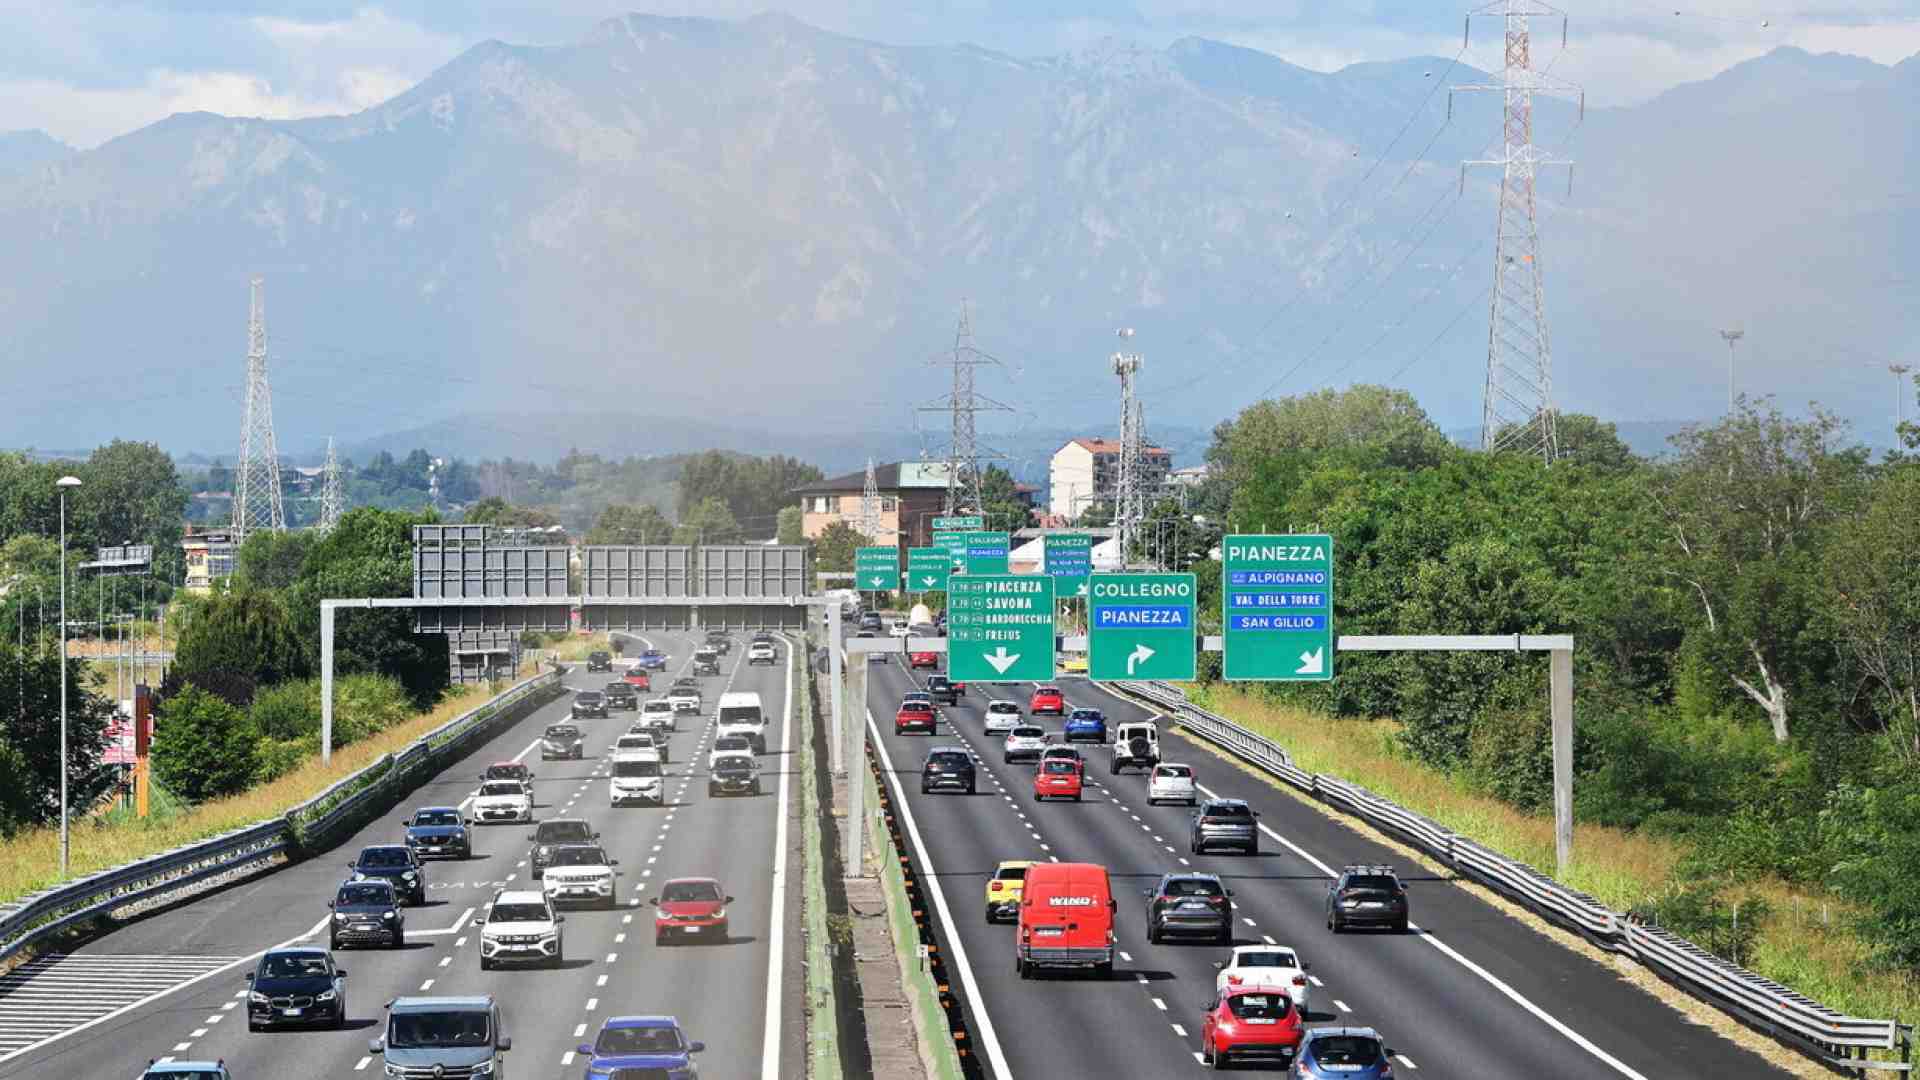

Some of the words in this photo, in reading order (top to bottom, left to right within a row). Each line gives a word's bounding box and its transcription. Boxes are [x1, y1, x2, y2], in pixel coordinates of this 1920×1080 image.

[1229, 546, 1325, 561] PIANEZZA
[1248, 573, 1324, 584] ALPIGNANO
[985, 581, 1042, 593] PIACENZA
[1094, 583, 1190, 597] COLLEGNO
[986, 598, 1032, 609] SAVONA
[1235, 595, 1253, 606] VAL
[1258, 595, 1287, 606] DELLA
[1291, 595, 1321, 606] TORRE
[1102, 610, 1182, 624] PIANEZZA
[1241, 617, 1269, 628] SAN
[1274, 617, 1314, 628] GILLIO
[1049, 896, 1091, 906] WIND
